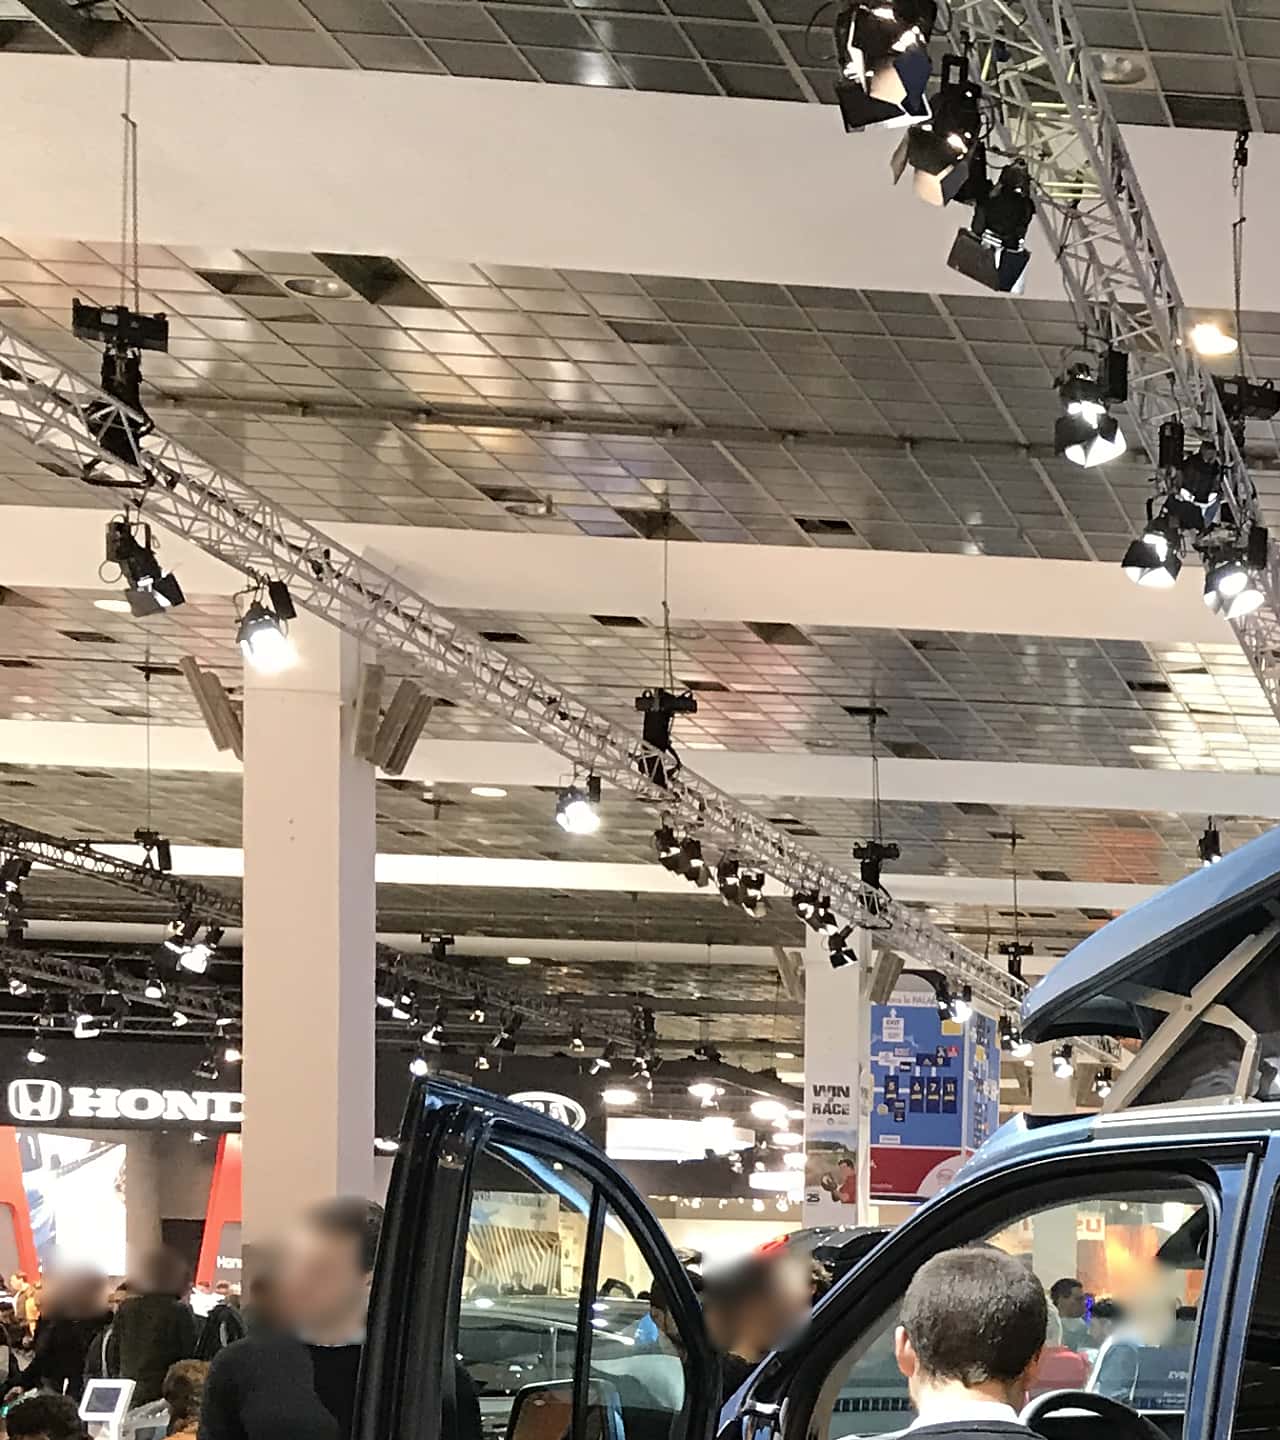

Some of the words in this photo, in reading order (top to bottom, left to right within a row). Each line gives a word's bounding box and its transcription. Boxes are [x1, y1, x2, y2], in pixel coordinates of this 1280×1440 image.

[812, 1084, 850, 1098] WIN
[68, 1087, 245, 1122] HOND
[812, 1103, 850, 1116] RACE
